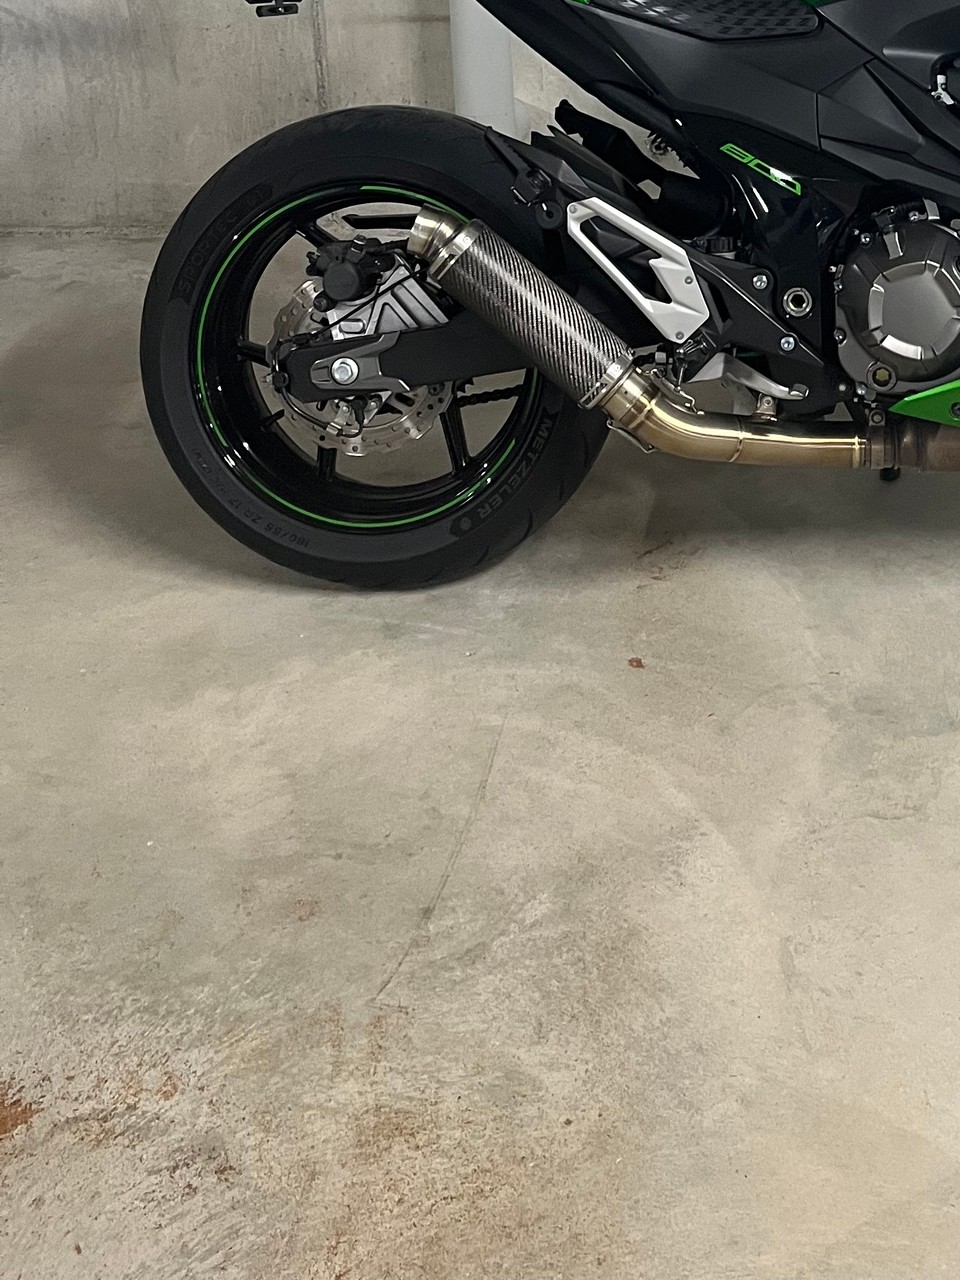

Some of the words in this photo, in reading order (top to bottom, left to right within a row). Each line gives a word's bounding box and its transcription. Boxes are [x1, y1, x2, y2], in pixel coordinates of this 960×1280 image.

[477, 419, 553, 518] METZELER
[244, 508, 263, 525] ZR
[264, 522, 311, 548] 180/55
